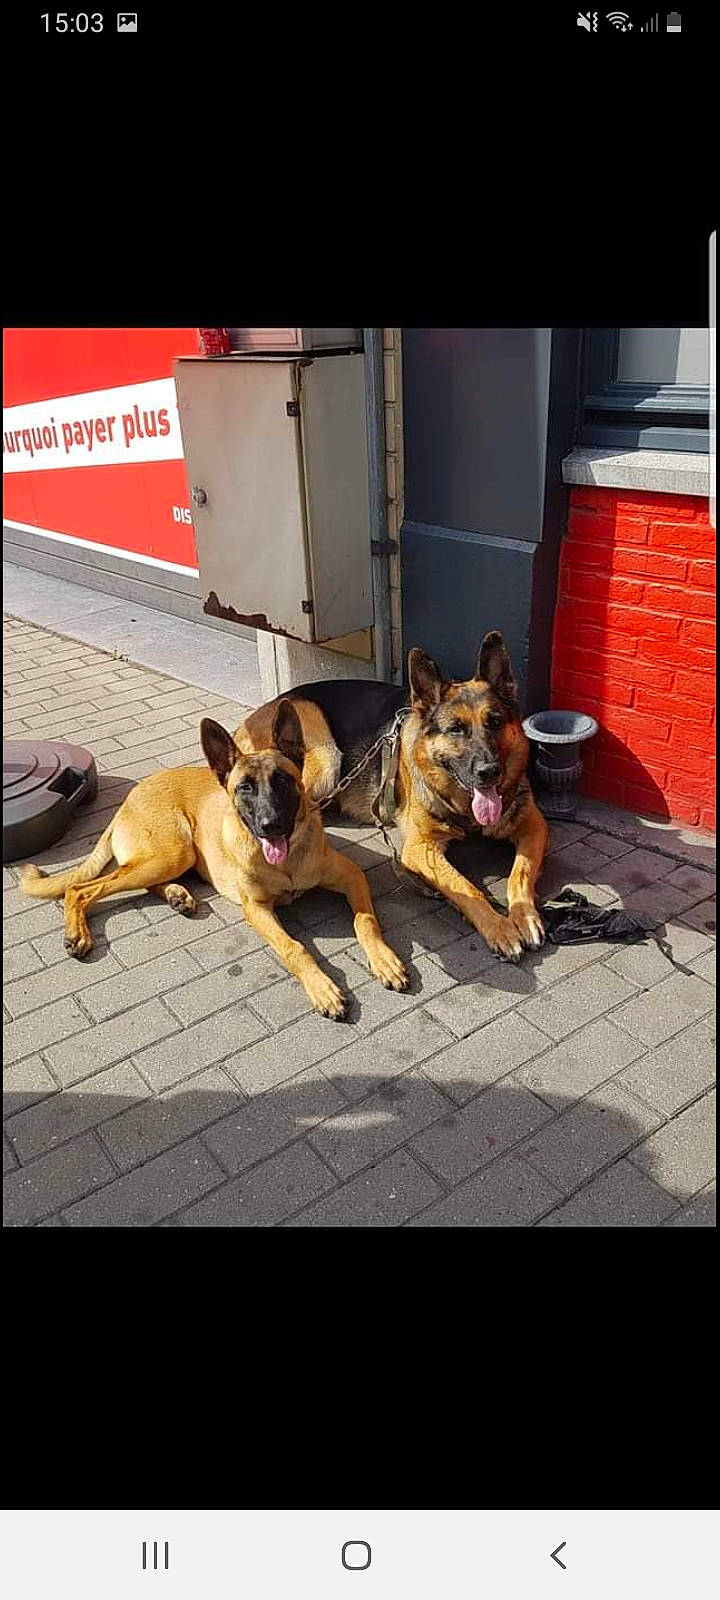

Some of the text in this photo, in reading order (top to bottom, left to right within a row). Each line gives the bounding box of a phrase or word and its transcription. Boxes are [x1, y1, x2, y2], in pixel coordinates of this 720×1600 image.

[3, 405, 171, 458] urquoi payer plus
